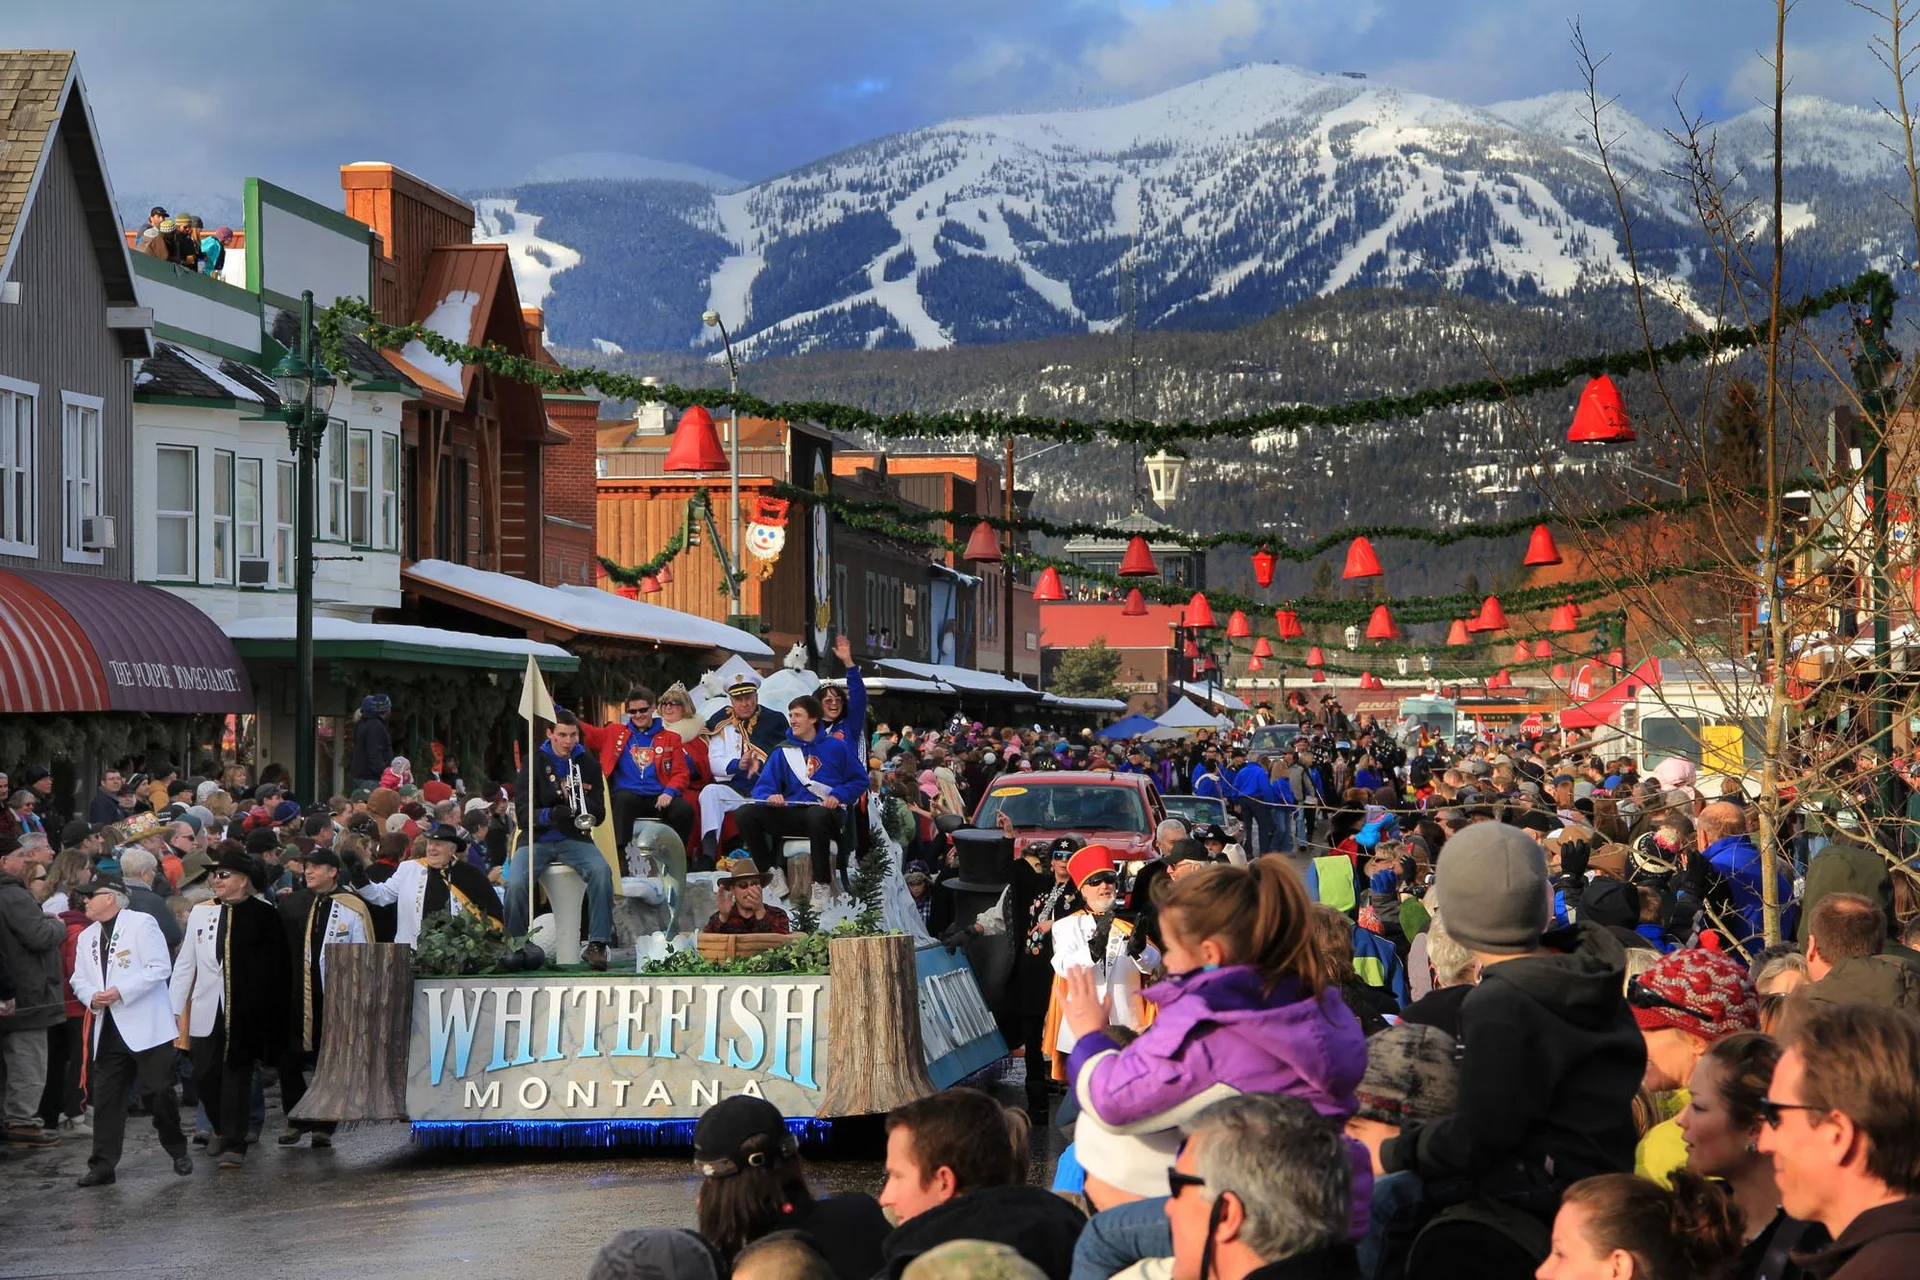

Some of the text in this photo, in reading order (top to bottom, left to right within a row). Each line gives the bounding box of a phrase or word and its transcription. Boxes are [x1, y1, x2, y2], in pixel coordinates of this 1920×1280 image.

[108, 660, 135, 687] THE
[132, 662, 174, 689] PURPLE
[1522, 725, 1541, 734] STOP
[422, 982, 825, 1091] WHITEFISH
[464, 1074, 765, 1109] MONTANA
